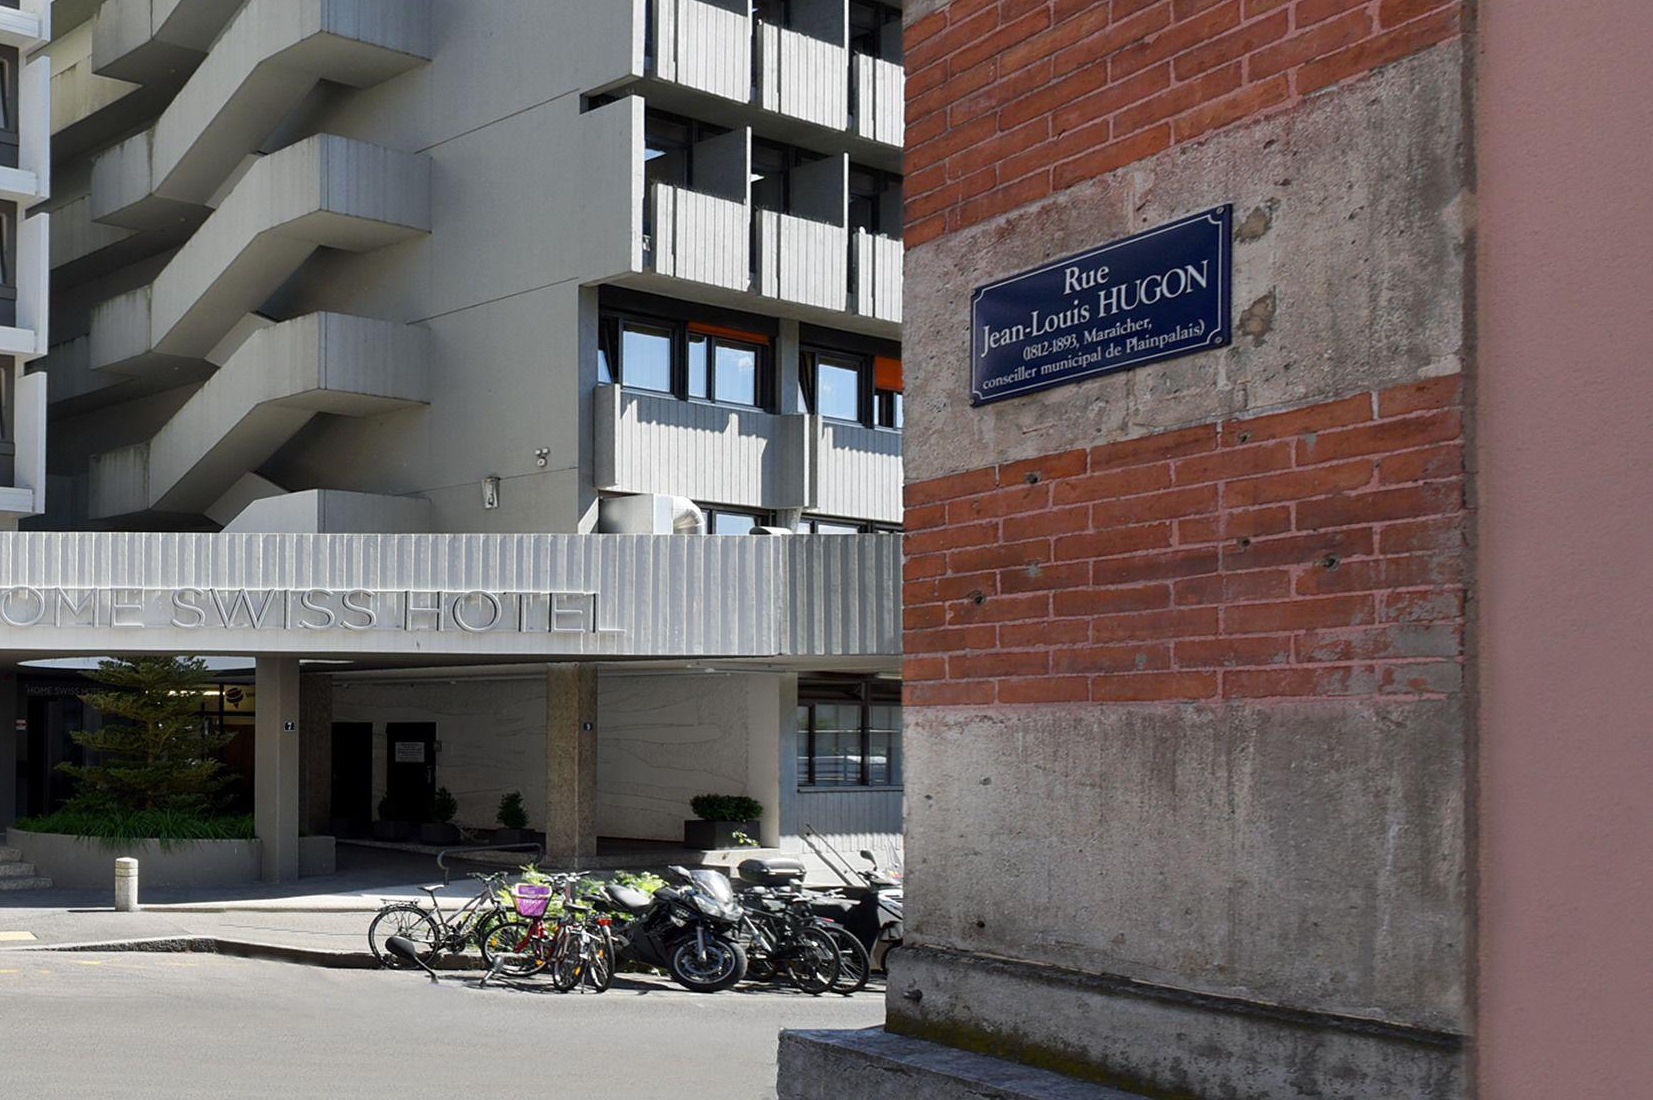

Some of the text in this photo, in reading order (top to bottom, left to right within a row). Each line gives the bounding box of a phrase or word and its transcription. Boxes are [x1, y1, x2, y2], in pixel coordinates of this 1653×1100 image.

[1063, 264, 1110, 296] Rue
[981, 259, 1209, 358] Jean-Louis HUGON
[982, 319, 1205, 390] conseiller municipal de Plainpalais)
[1023, 333, 1080, 361] (1812-1893,
[169, 587, 378, 631] SWISS
[403, 589, 627, 633] HOTEL
